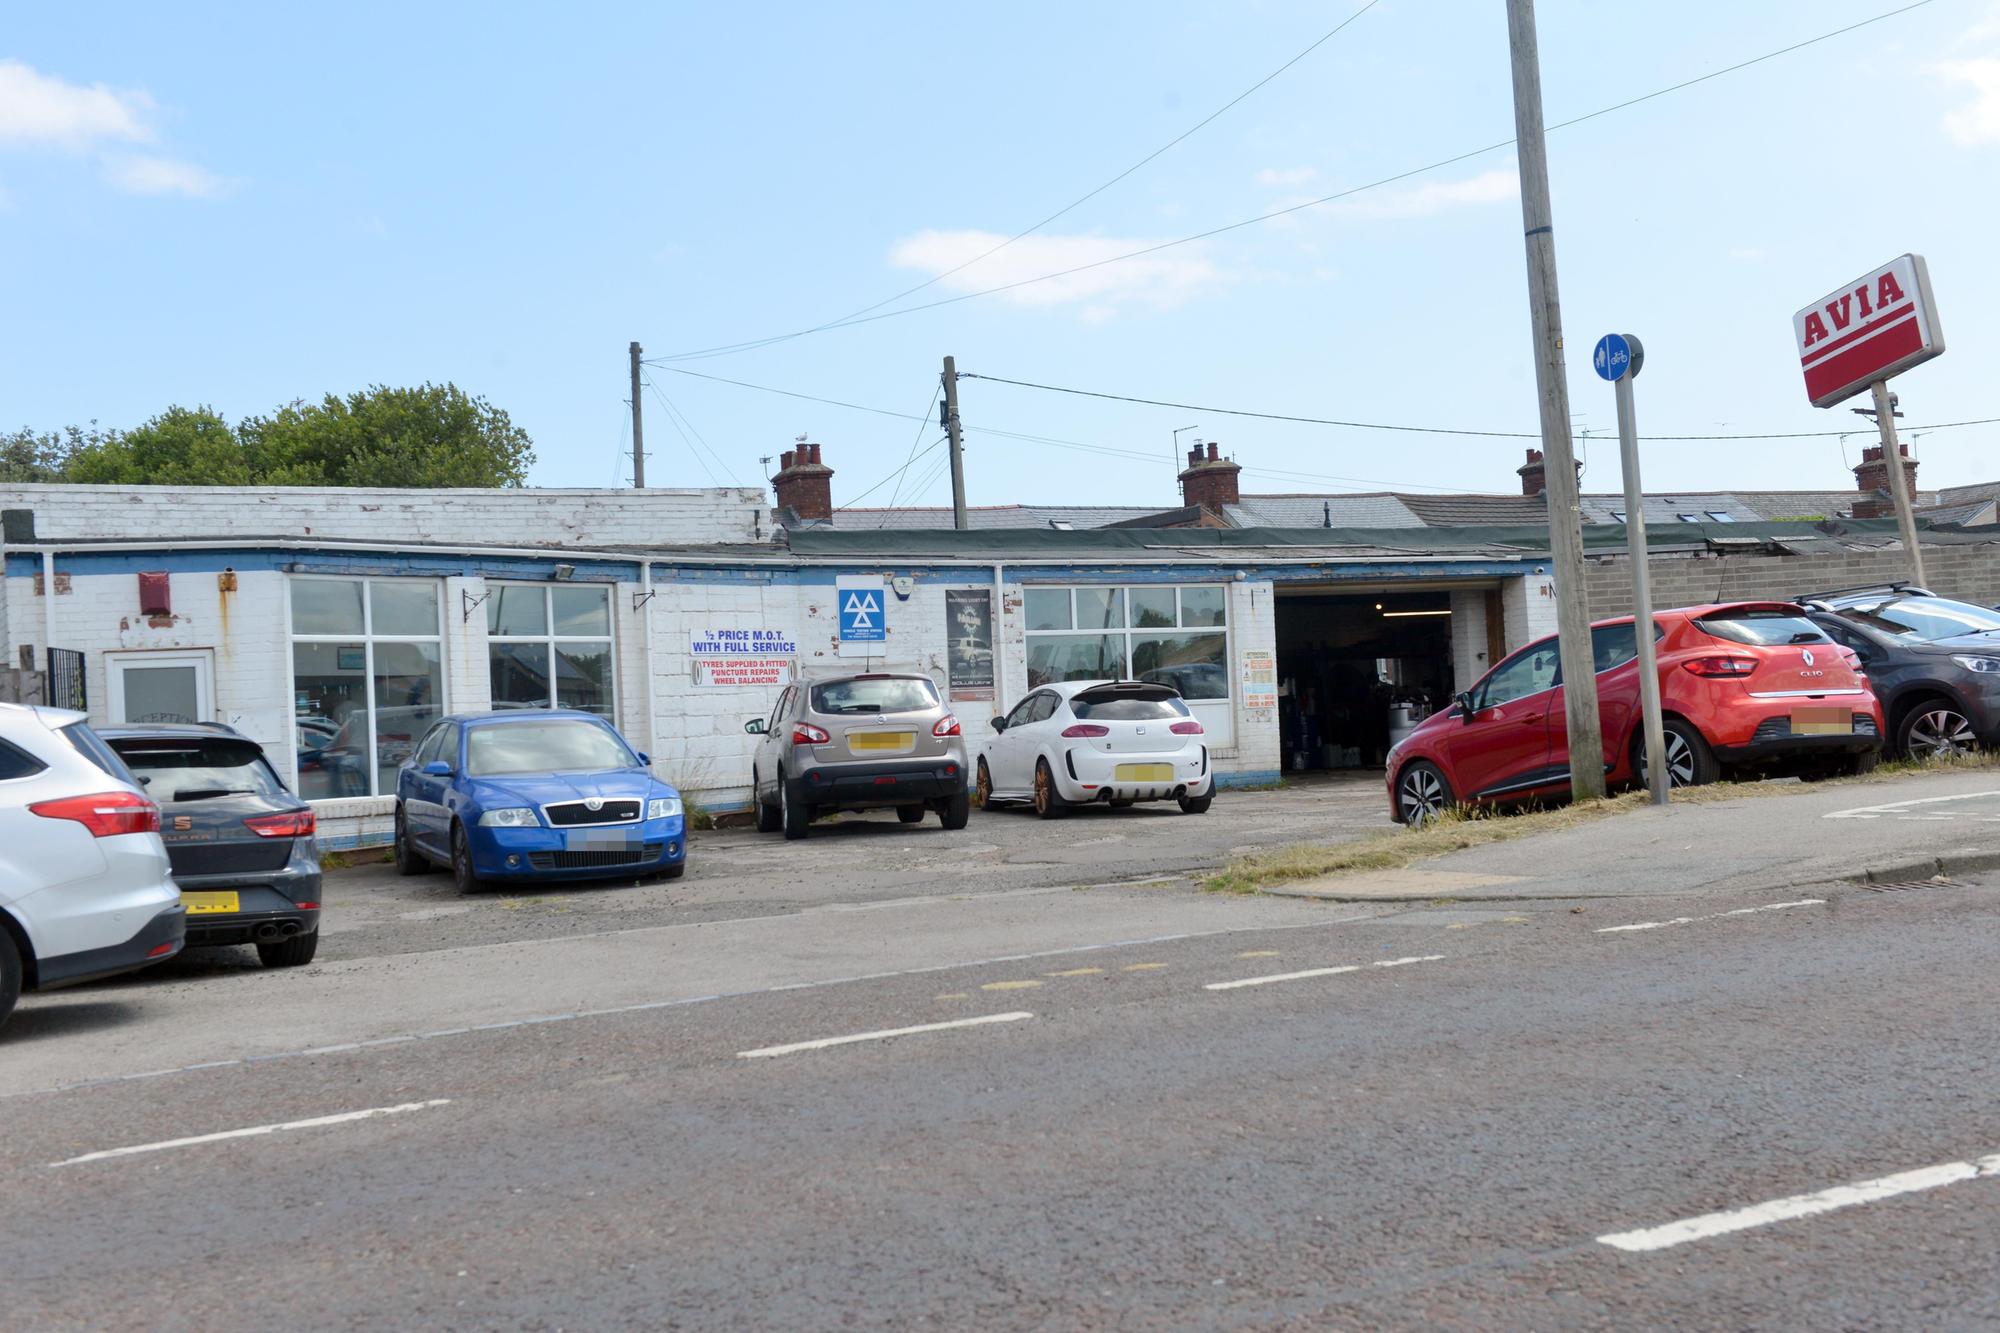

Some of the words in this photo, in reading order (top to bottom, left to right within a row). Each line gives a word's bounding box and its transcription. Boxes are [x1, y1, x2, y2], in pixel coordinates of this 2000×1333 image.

[1803, 271, 1905, 348] AVIA
[718, 630, 749, 640] PRICE
[752, 630, 784, 640] M.O.T.
[693, 642, 721, 652] WITH
[724, 642, 749, 652] FULL
[752, 642, 796, 652] SERVICE
[702, 660, 724, 668] TYRES
[714, 677, 737, 685] WHEEL
[738, 676, 778, 684] BALANCING
